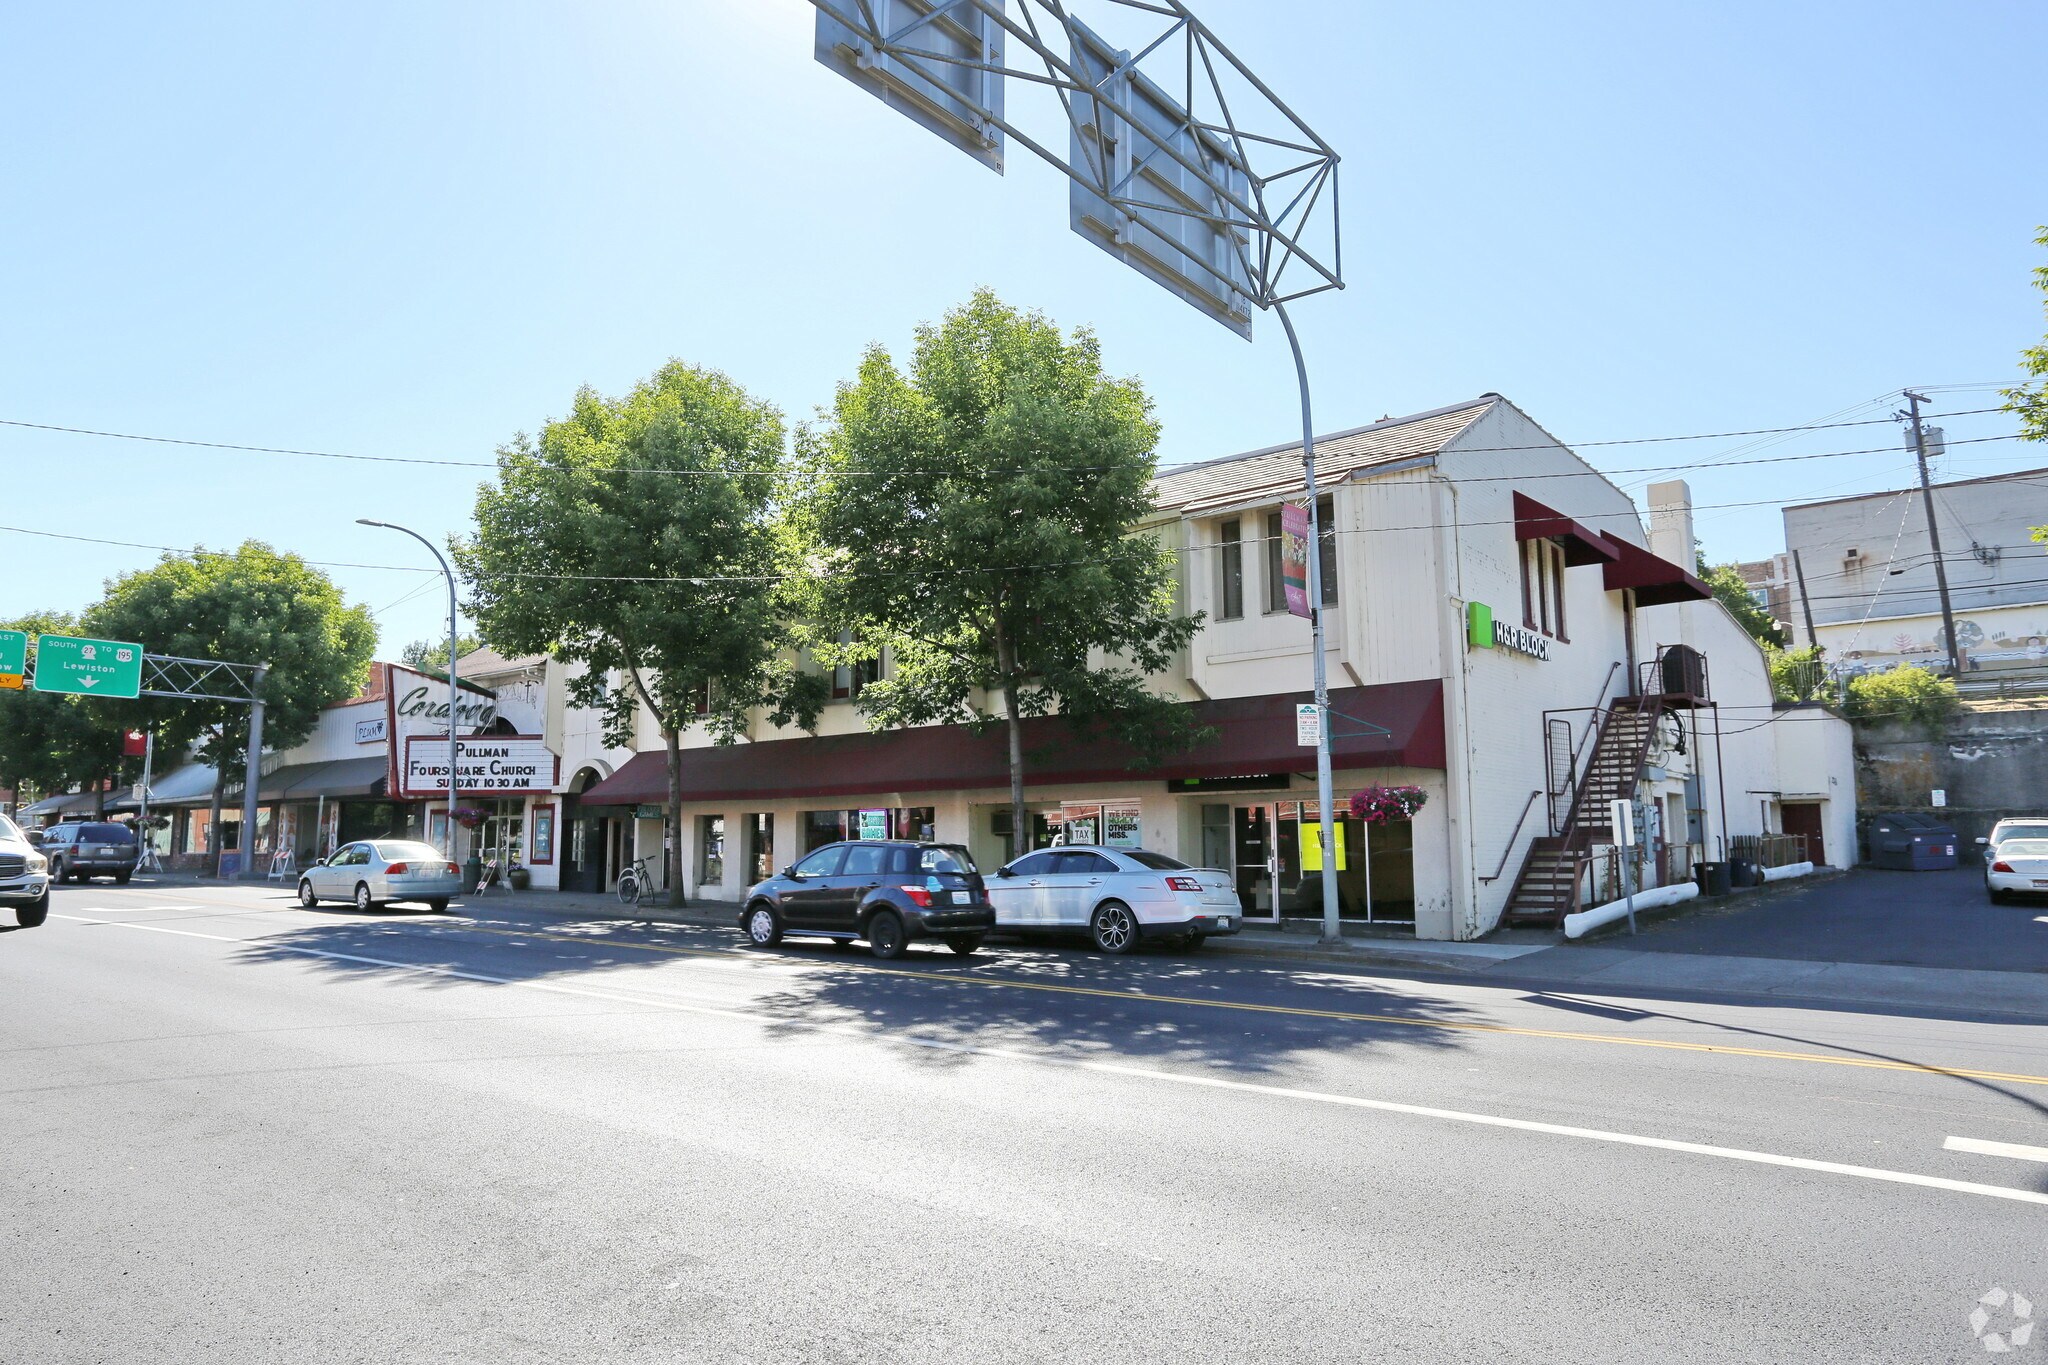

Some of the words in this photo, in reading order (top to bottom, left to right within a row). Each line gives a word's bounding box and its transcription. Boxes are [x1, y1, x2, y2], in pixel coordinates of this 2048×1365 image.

[1496, 620, 1518, 648] H&R
[1519, 630, 1551, 661] BLOCK
[48, 640, 77, 649] SOUTH
[83, 646, 94, 654] 27
[101, 645, 112, 653] TO
[118, 651, 131, 660] 195
[63, 661, 115, 673] Lewiston
[397, 686, 496, 724] Cordova
[410, 760, 485, 776] FOURSUARE
[436, 778, 479, 788] SUDAY
[484, 778, 495, 788] 10
[497, 778, 510, 788] 30
[512, 778, 530, 788] AM
[1108, 809, 1120, 817] WE
[1121, 809, 1139, 817] FIND
[1108, 824, 1138, 832] OTHERS
[1075, 829, 1089, 839] TAX
[1108, 831, 1128, 839] MISS.
